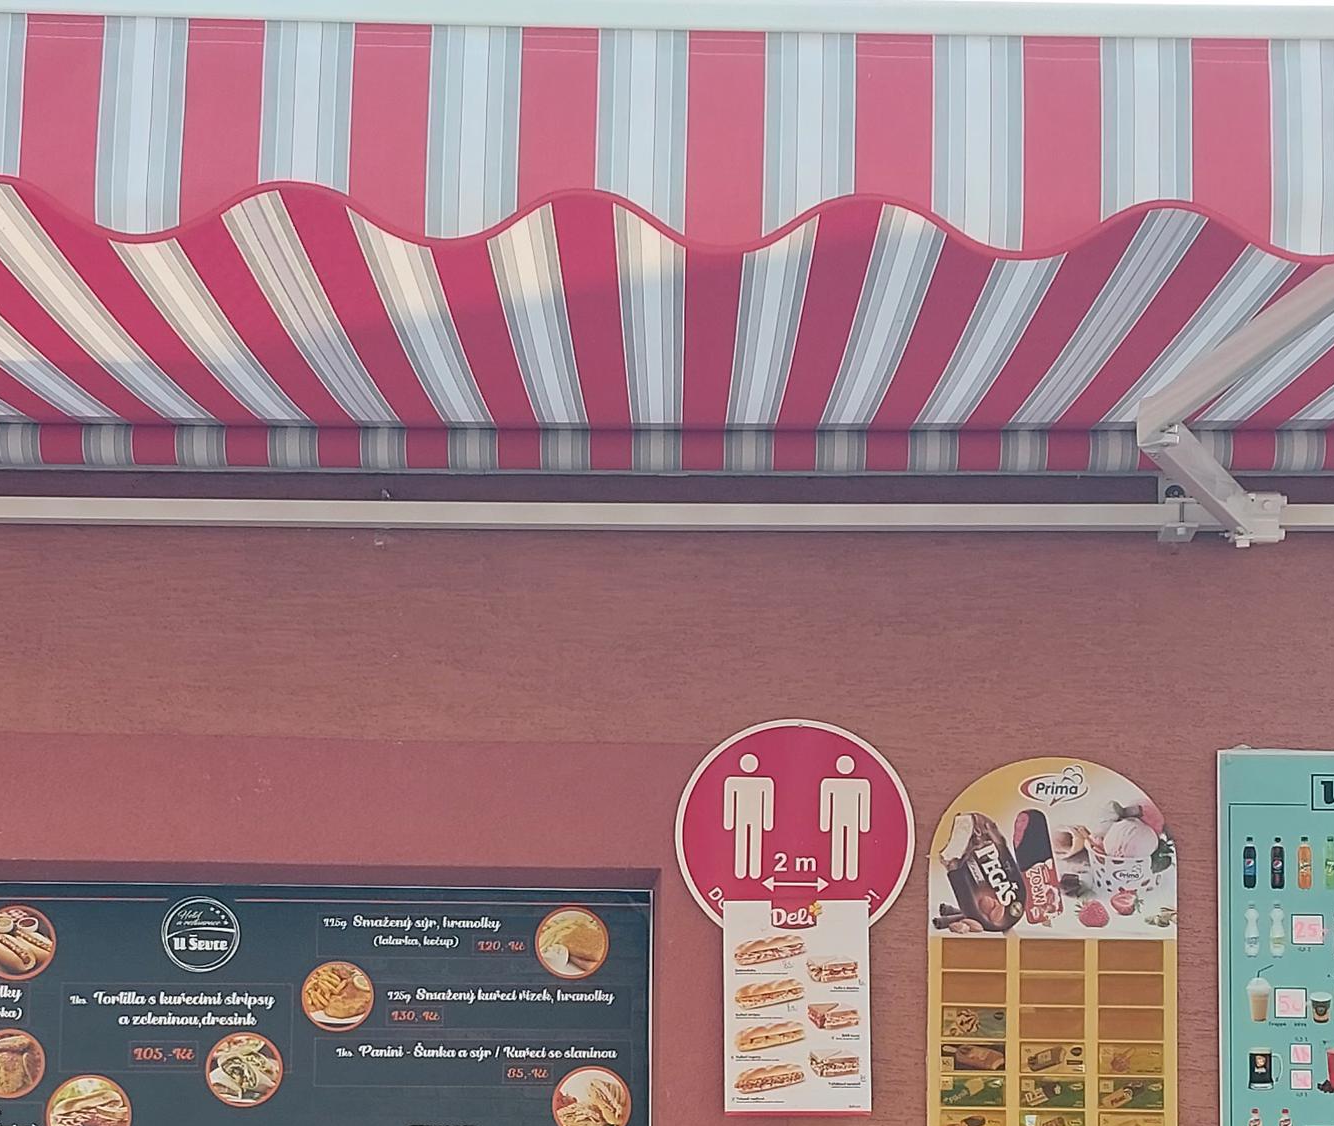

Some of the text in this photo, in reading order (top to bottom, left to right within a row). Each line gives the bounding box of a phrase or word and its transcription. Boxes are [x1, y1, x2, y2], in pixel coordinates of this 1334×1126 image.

[1035, 781, 1079, 796] Prima
[774, 853, 816, 872] 2 m
[352, 915, 412, 930] Smažený
[442, 916, 501, 931] hranolky
[772, 908, 816, 926] Deli
